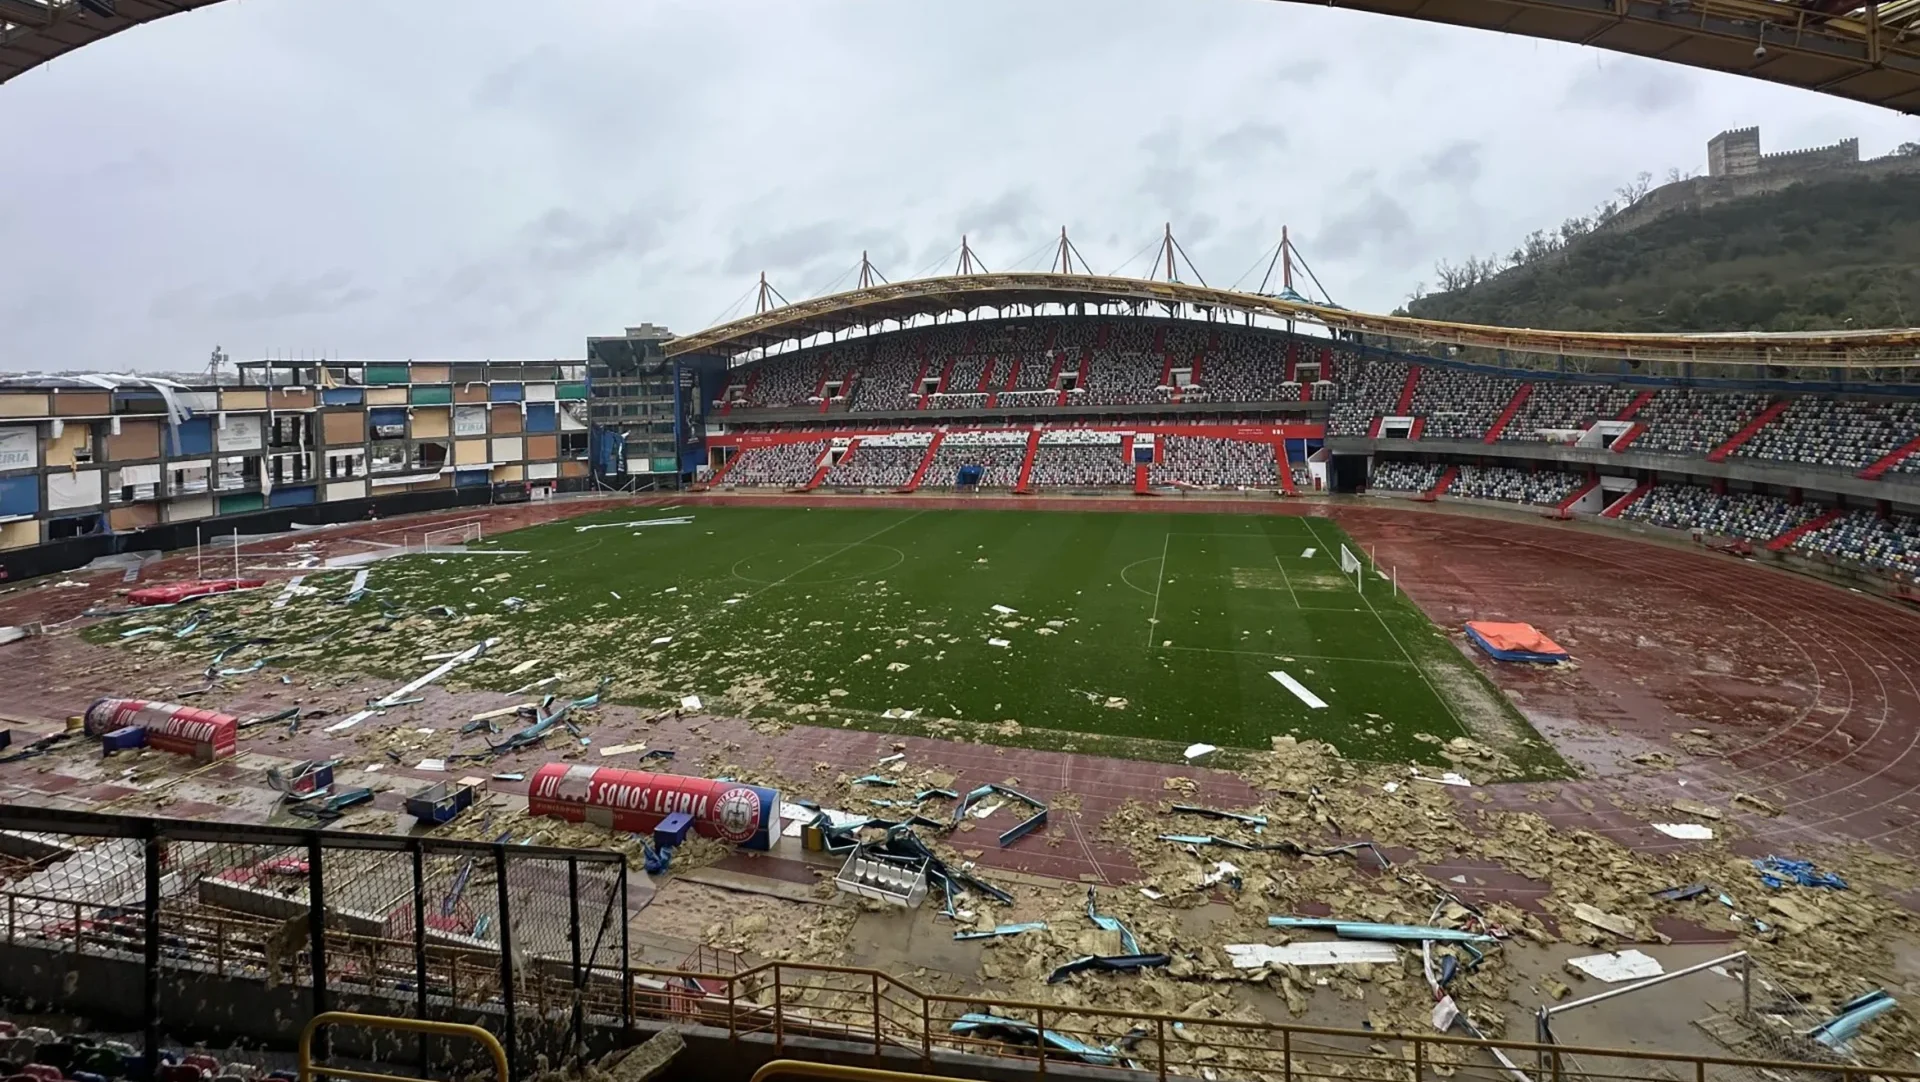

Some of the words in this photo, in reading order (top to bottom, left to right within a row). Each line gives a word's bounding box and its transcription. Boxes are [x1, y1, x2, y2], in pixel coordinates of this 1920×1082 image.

[182, 720, 216, 742] UNIÃO
[597, 782, 651, 810] SOMOS
[654, 789, 708, 819] LEIRIA
